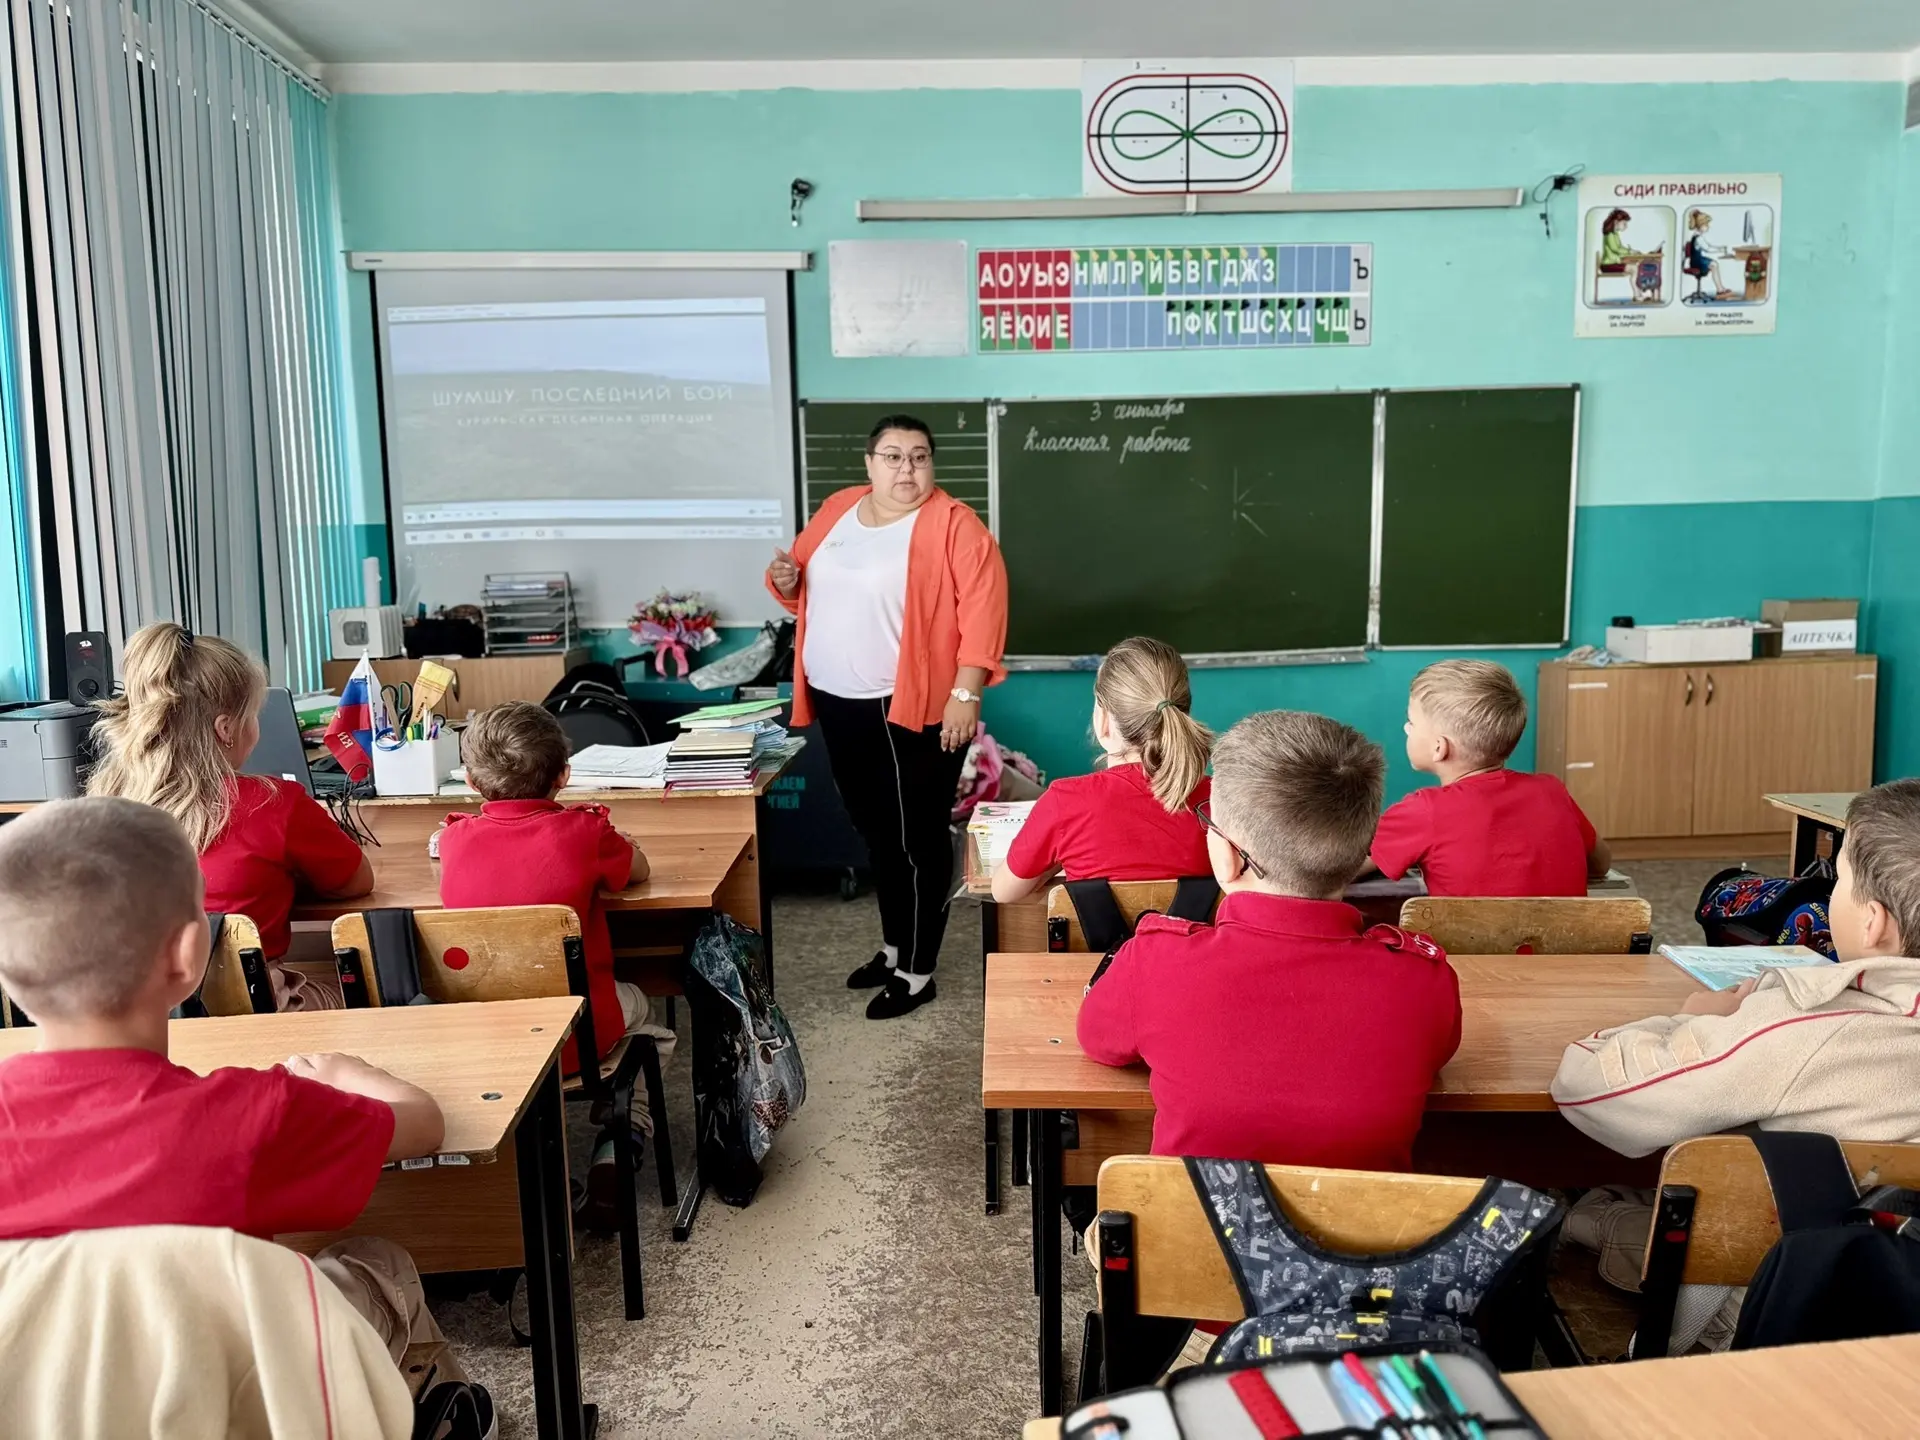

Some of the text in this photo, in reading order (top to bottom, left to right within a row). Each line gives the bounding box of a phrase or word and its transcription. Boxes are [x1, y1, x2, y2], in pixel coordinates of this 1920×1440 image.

[1614, 182, 1748, 199] СИДИ ПРАВИЛЬНО
[531, 384, 671, 403] ПОСЛЕДНИЙ
[684, 384, 733, 401] БОЙ
[1090, 397, 1186, 421] 3 сентября
[640, 413, 713, 425] ОПЕРАЦИЯ
[1024, 426, 1192, 464] Классная работа
[1788, 631, 1853, 645] АПТЕЧКА
[1776, 927, 1790, 944] Web
